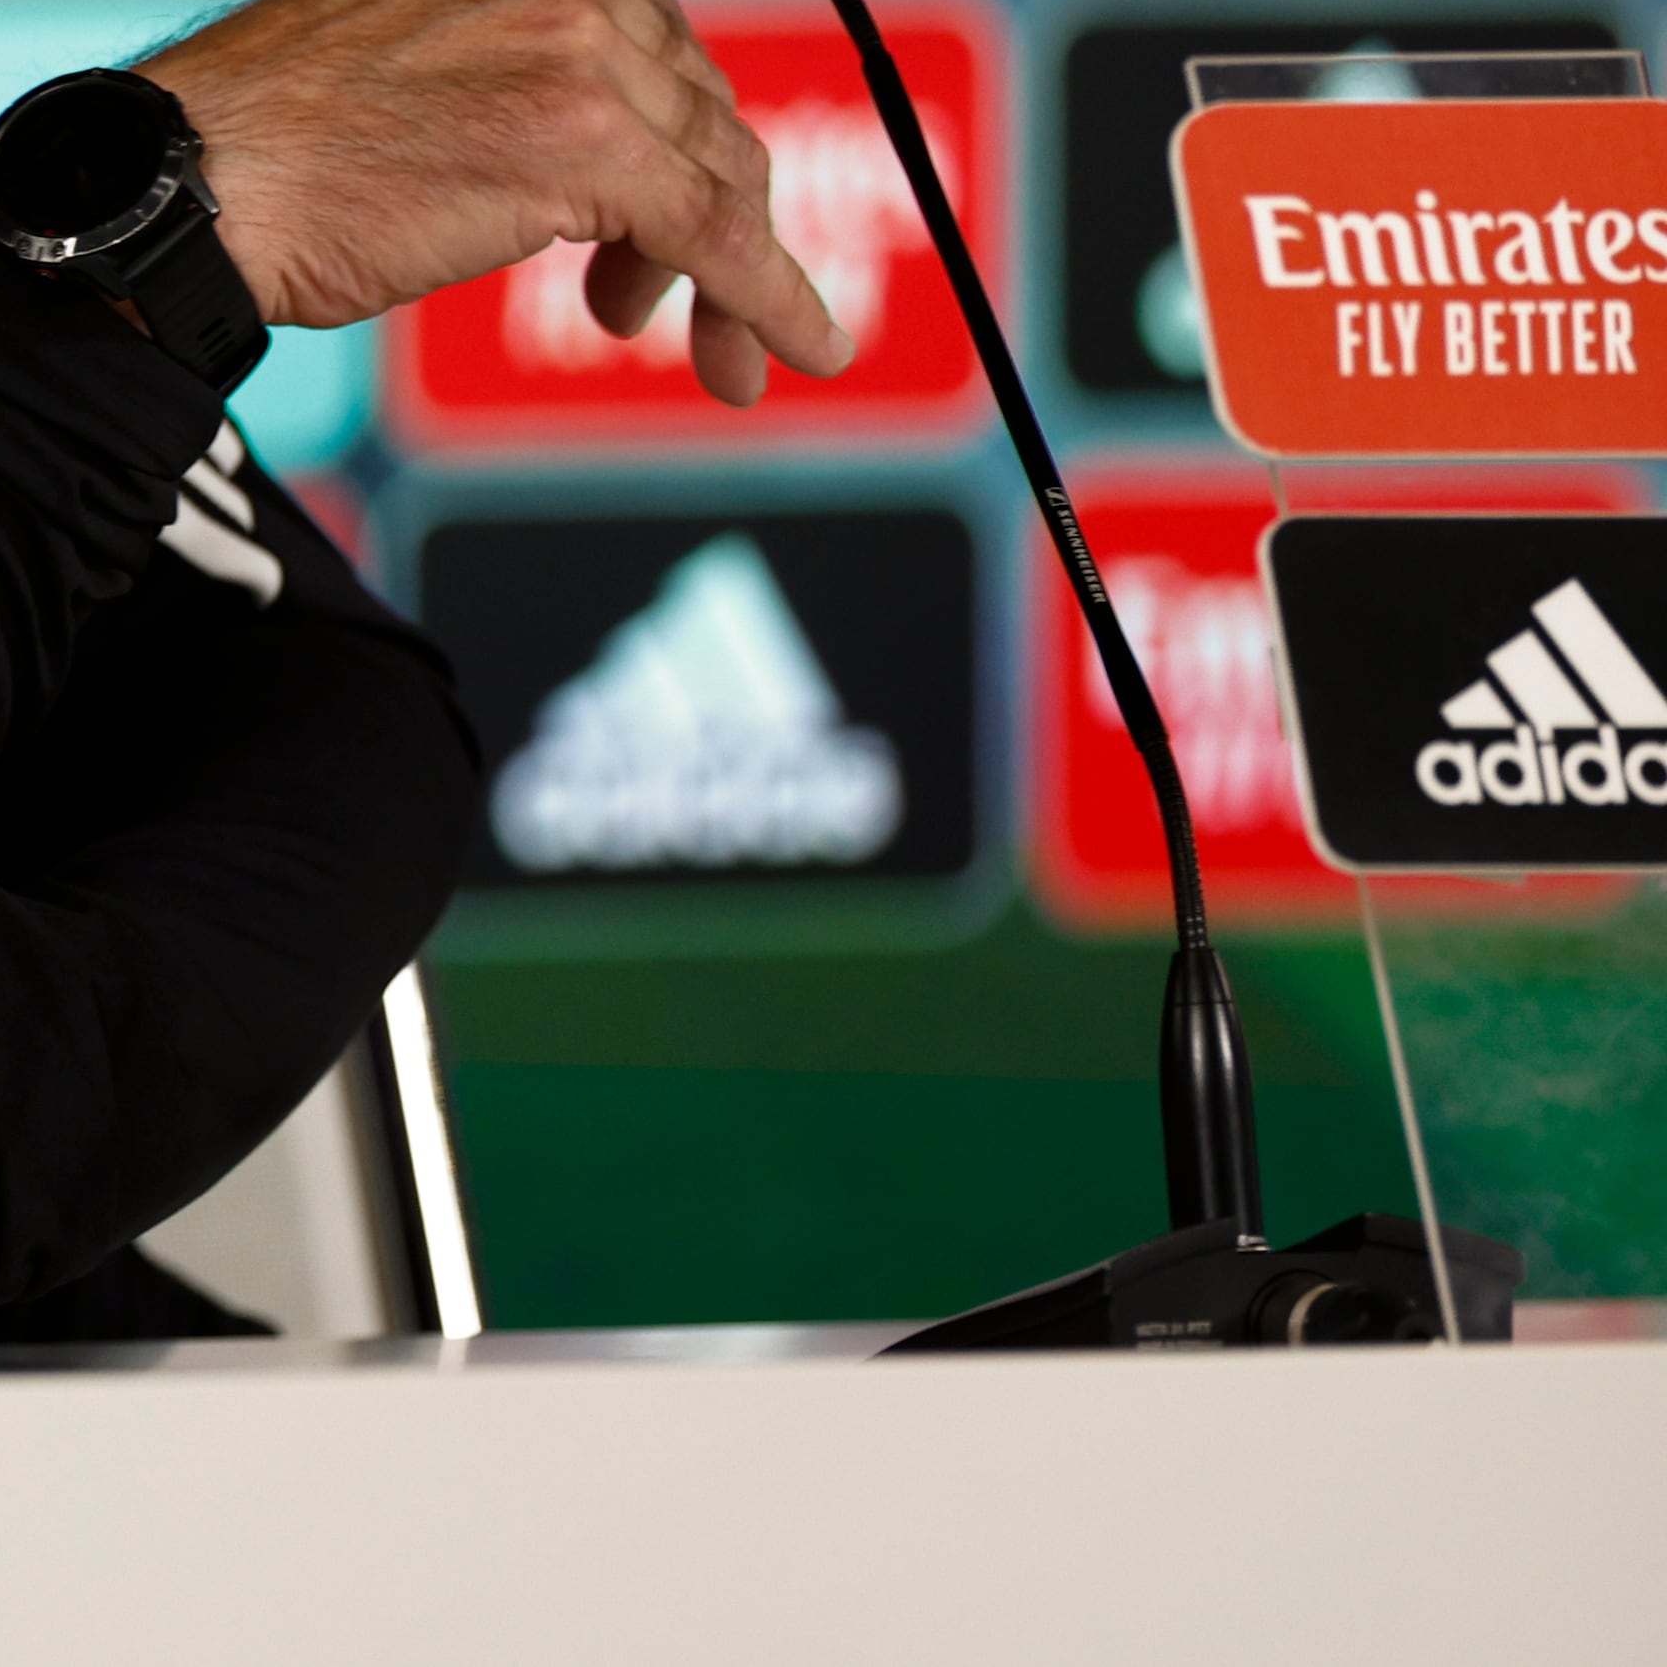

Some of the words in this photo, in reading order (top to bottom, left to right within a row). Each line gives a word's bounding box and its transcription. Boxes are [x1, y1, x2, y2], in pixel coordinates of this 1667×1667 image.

[1243, 189, 1667, 288] Emirates
[1336, 302, 1421, 377] FLY
[1444, 299, 1637, 376] BETTER
[1057, 508, 1108, 604] SENNHEISER
[1415, 723, 1667, 806] adida
